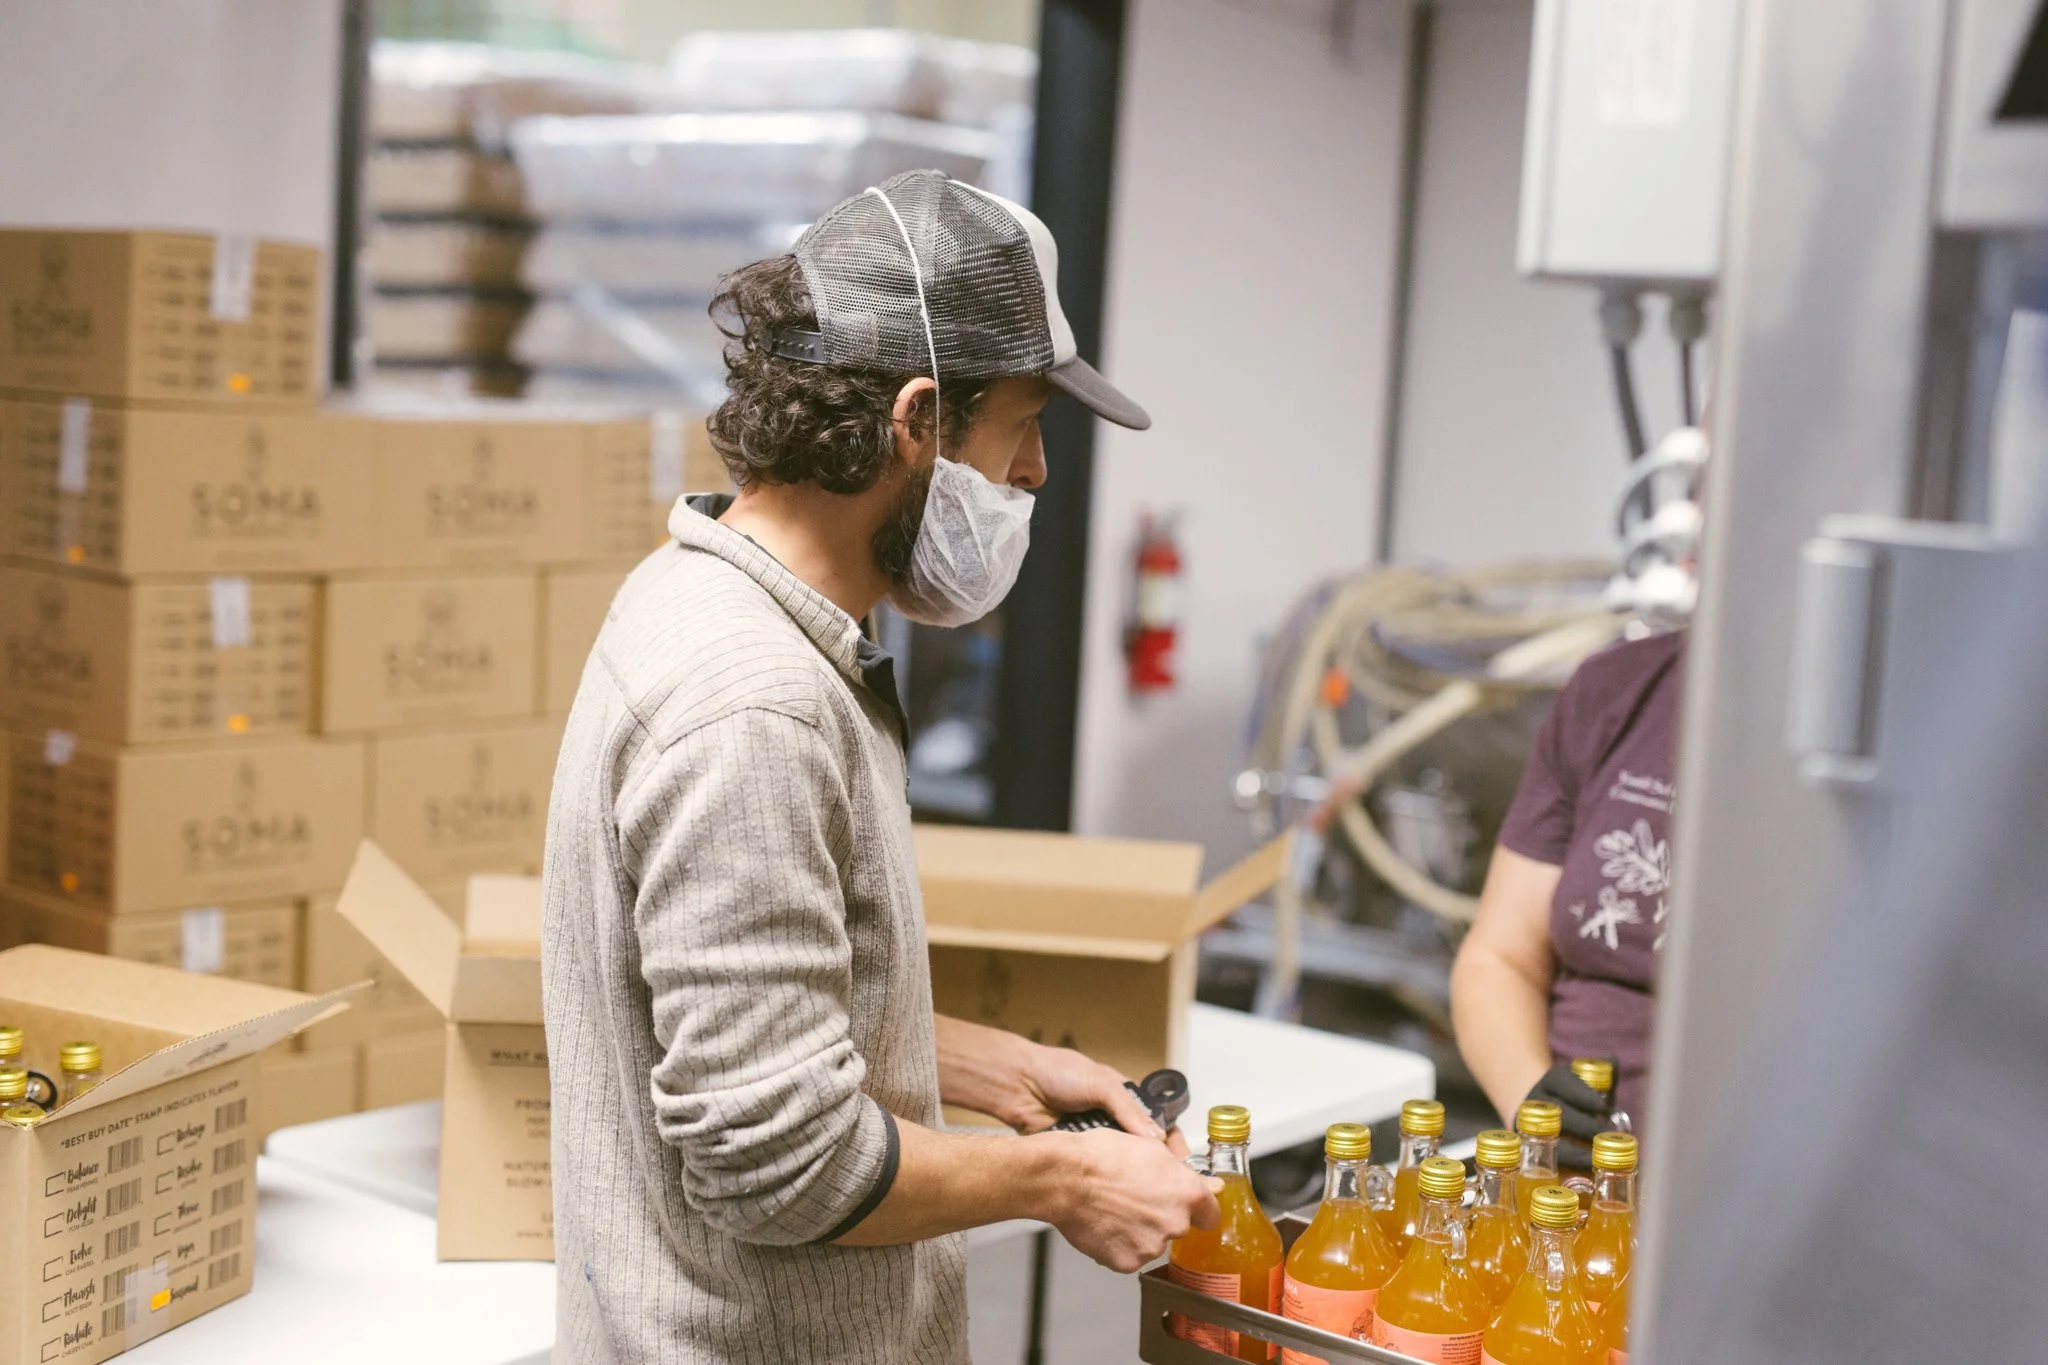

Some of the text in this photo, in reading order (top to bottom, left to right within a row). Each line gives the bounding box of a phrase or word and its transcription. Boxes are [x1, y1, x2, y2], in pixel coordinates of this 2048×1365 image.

[190, 483, 320, 523] SOMA
[425, 485, 539, 525] SOMA
[383, 645, 492, 684] SOMA
[423, 792, 535, 836] SOMA
[181, 815, 312, 857] SOMA
[88, 1125, 106, 1141] BUY
[134, 1106, 162, 1124] STAMP
[164, 1091, 207, 1114] INDICATES
[208, 1080, 239, 1097] FLAVOR
[67, 1161, 99, 1184] Balance
[66, 1194, 97, 1224] Delight
[70, 1242, 93, 1265] Evolve
[64, 1278, 95, 1308] Flourish
[63, 1321, 93, 1348] Radiate
